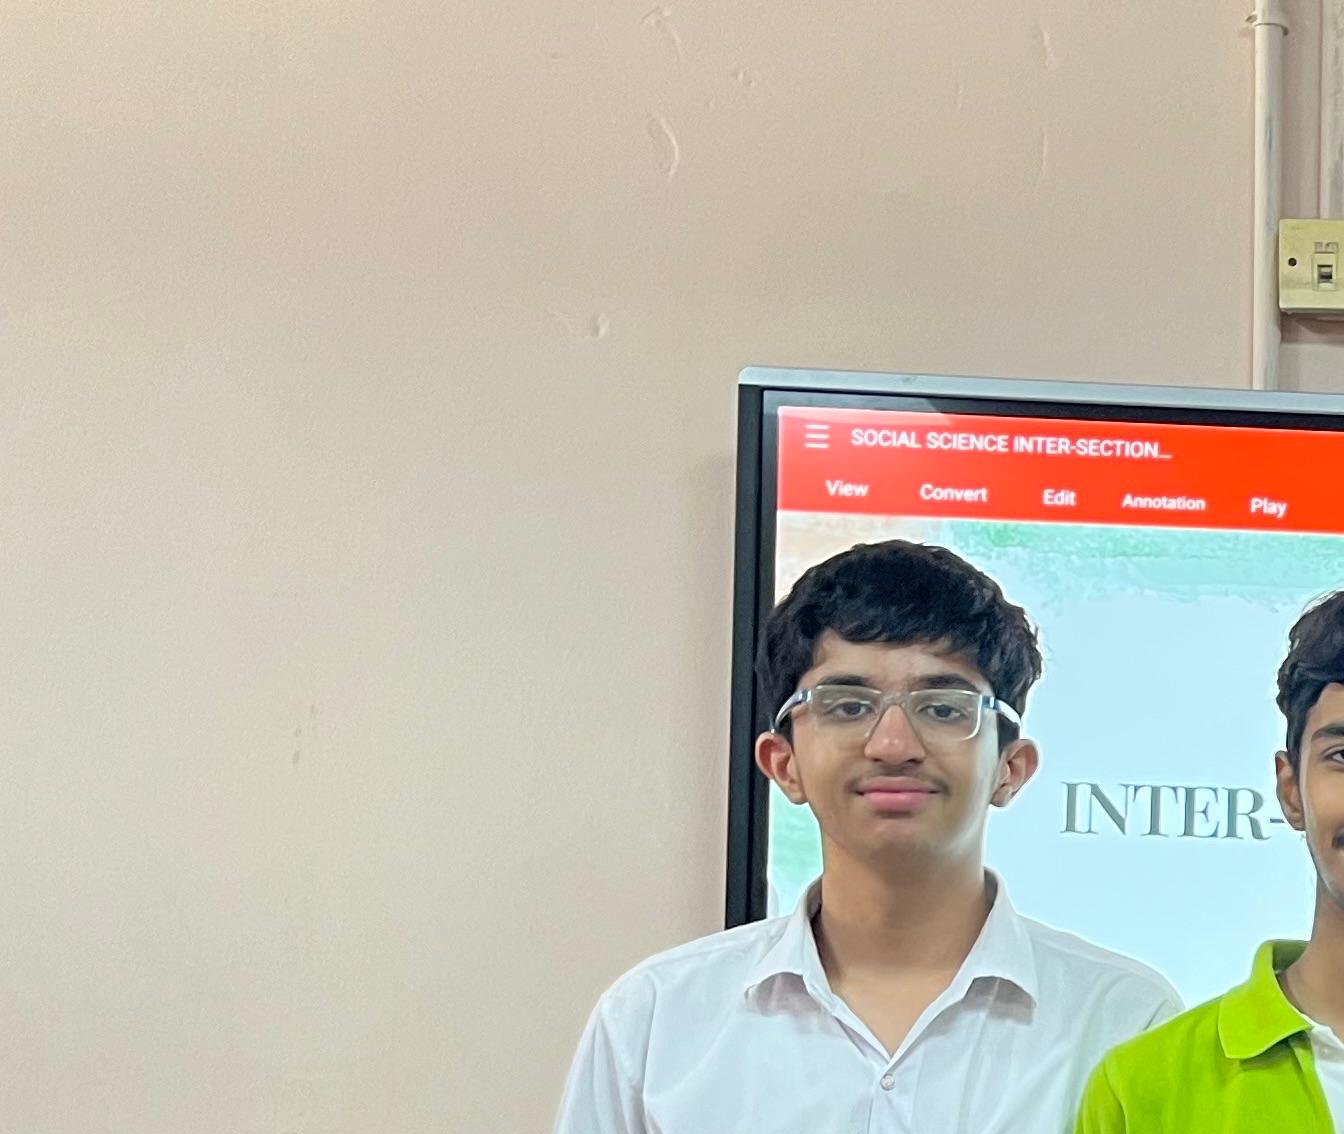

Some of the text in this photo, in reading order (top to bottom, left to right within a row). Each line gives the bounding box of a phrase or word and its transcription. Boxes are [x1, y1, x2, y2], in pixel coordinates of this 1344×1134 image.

[851, 428, 921, 450] SOCIAL
[926, 431, 1008, 453] SCIENCE
[825, 479, 869, 498] View
[920, 483, 988, 503] Convert
[1043, 487, 1077, 506] Edit
[1122, 493, 1207, 512] Annotation
[1250, 496, 1288, 518] Play
